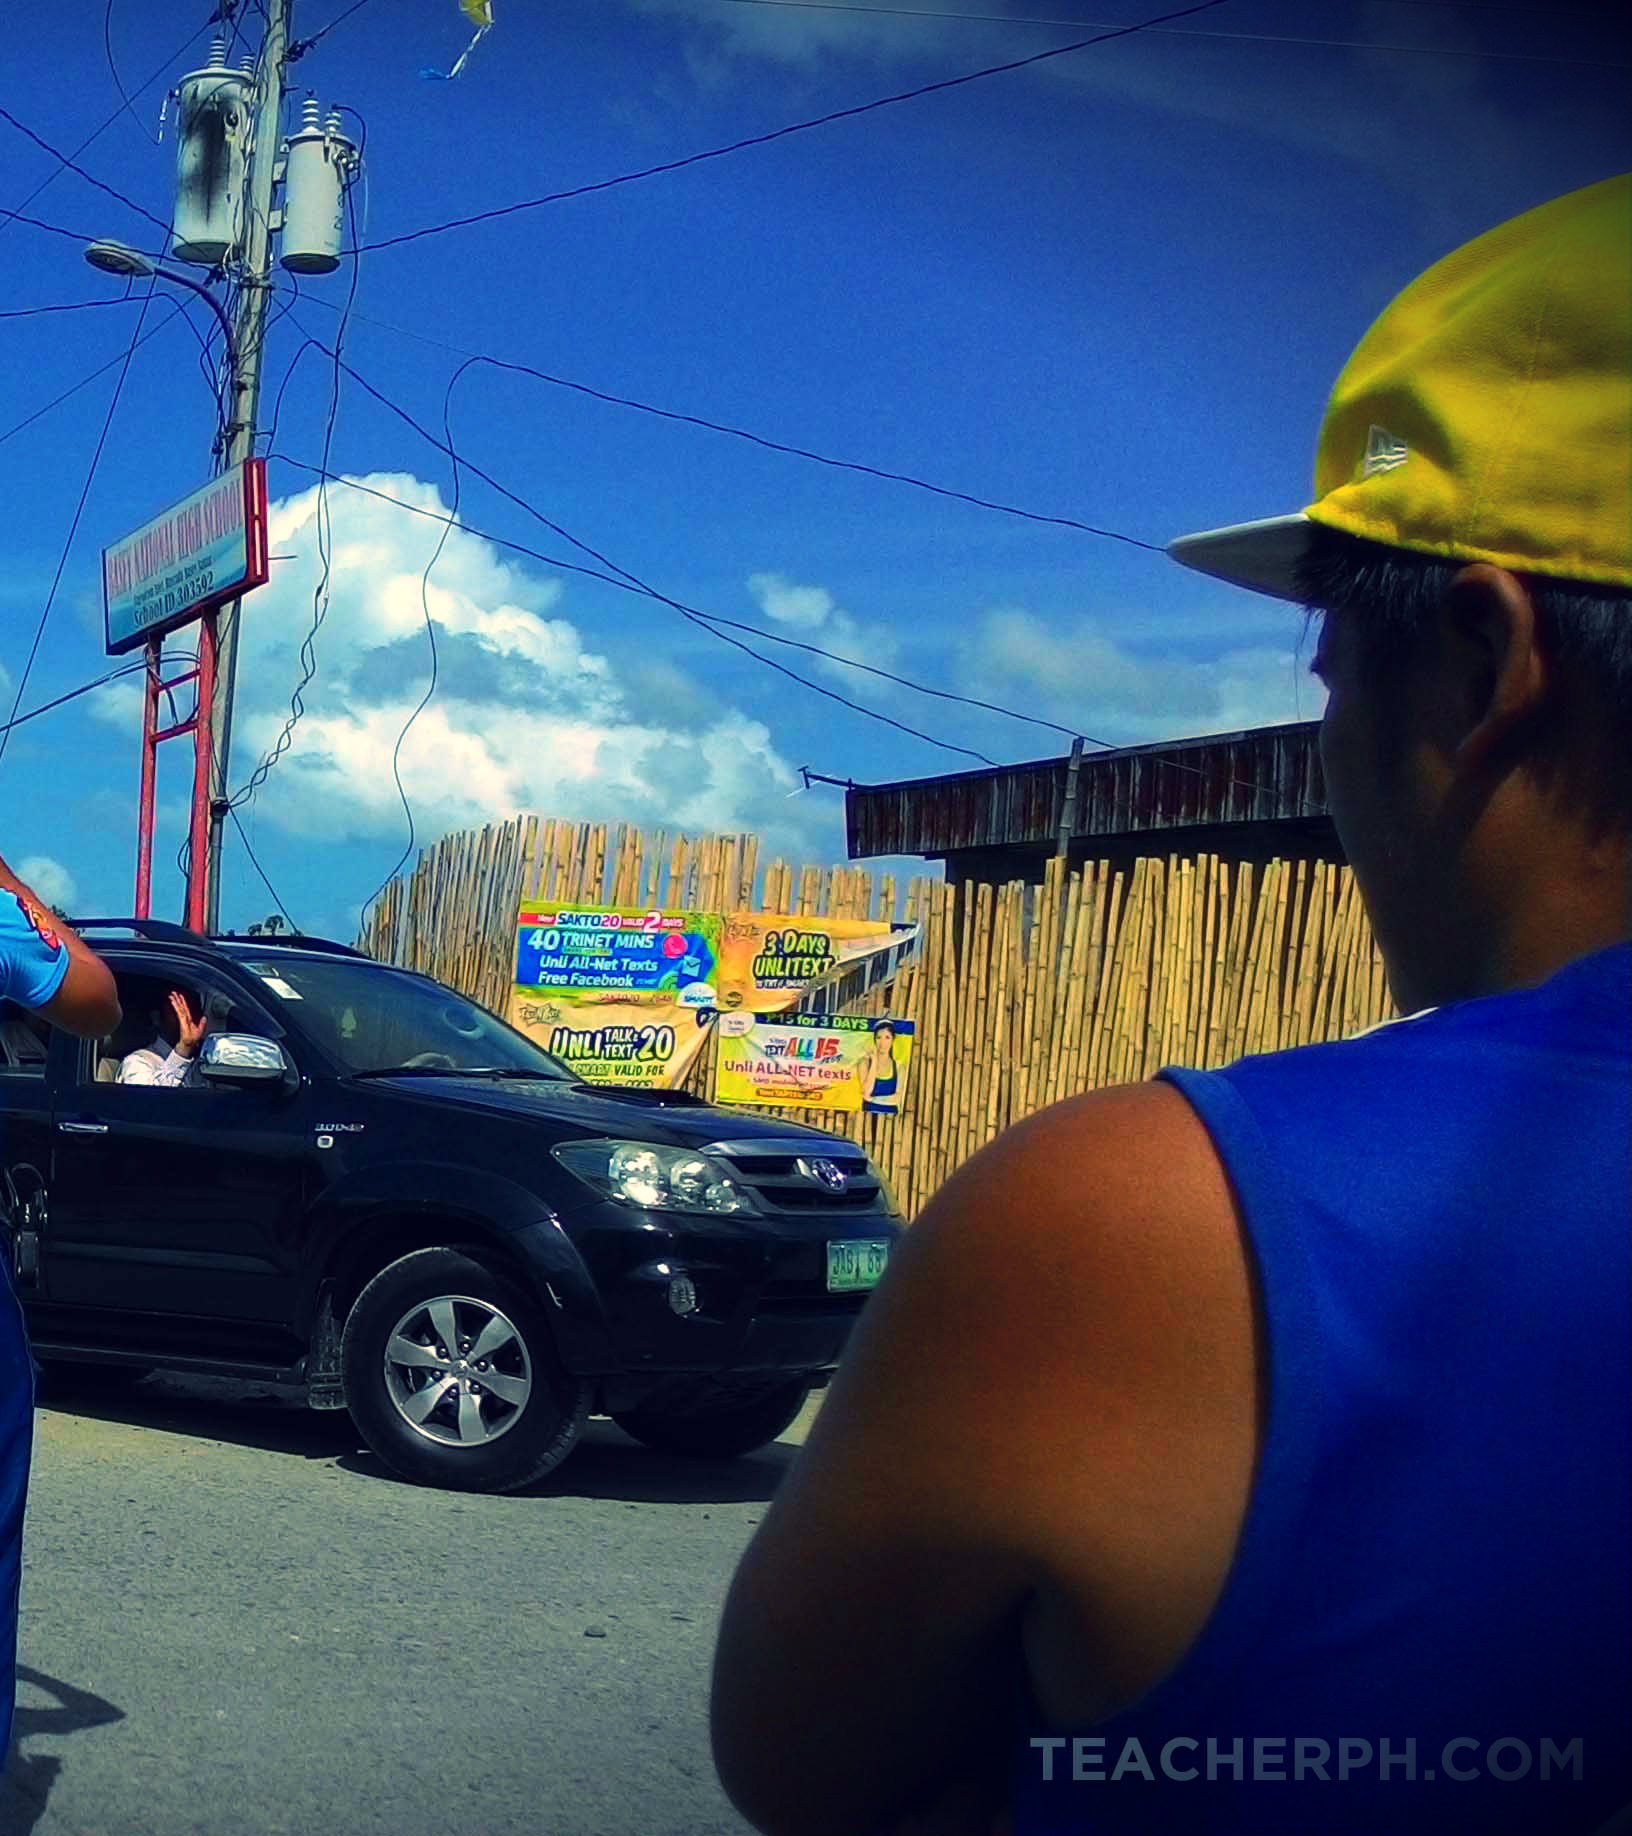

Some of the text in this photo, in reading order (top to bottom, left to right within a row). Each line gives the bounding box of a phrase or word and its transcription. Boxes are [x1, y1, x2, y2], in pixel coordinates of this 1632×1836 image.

[133, 595, 163, 629] School
[164, 590, 175, 614] ID
[176, 568, 214, 608] 303592
[556, 912, 620, 928] SAKTO20
[644, 911, 661, 933] 2
[661, 918, 684, 927] DAYS
[528, 929, 655, 950] 40 TRINET MINS
[765, 932, 779, 956] 3
[784, 930, 827, 955] DAYS
[539, 955, 658, 972] Unli All-Net Texts
[755, 956, 834, 978] UNLITEXT
[538, 971, 567, 985] Free
[570, 972, 634, 987] Facebook
[797, 1013, 817, 1026] for
[819, 1015, 829, 1027] 3
[832, 1016, 869, 1030] DAYS
[551, 1028, 603, 1060] UNLI
[604, 1028, 633, 1042] TALK
[638, 1027, 674, 1060] 20
[604, 1043, 634, 1058] TEXT
[785, 1037, 814, 1060] ALL
[816, 1038, 841, 1059] 15
[614, 1065, 642, 1076] VALID
[646, 1065, 665, 1077] FOR
[725, 1060, 852, 1081] Unli ALL-NET texts
